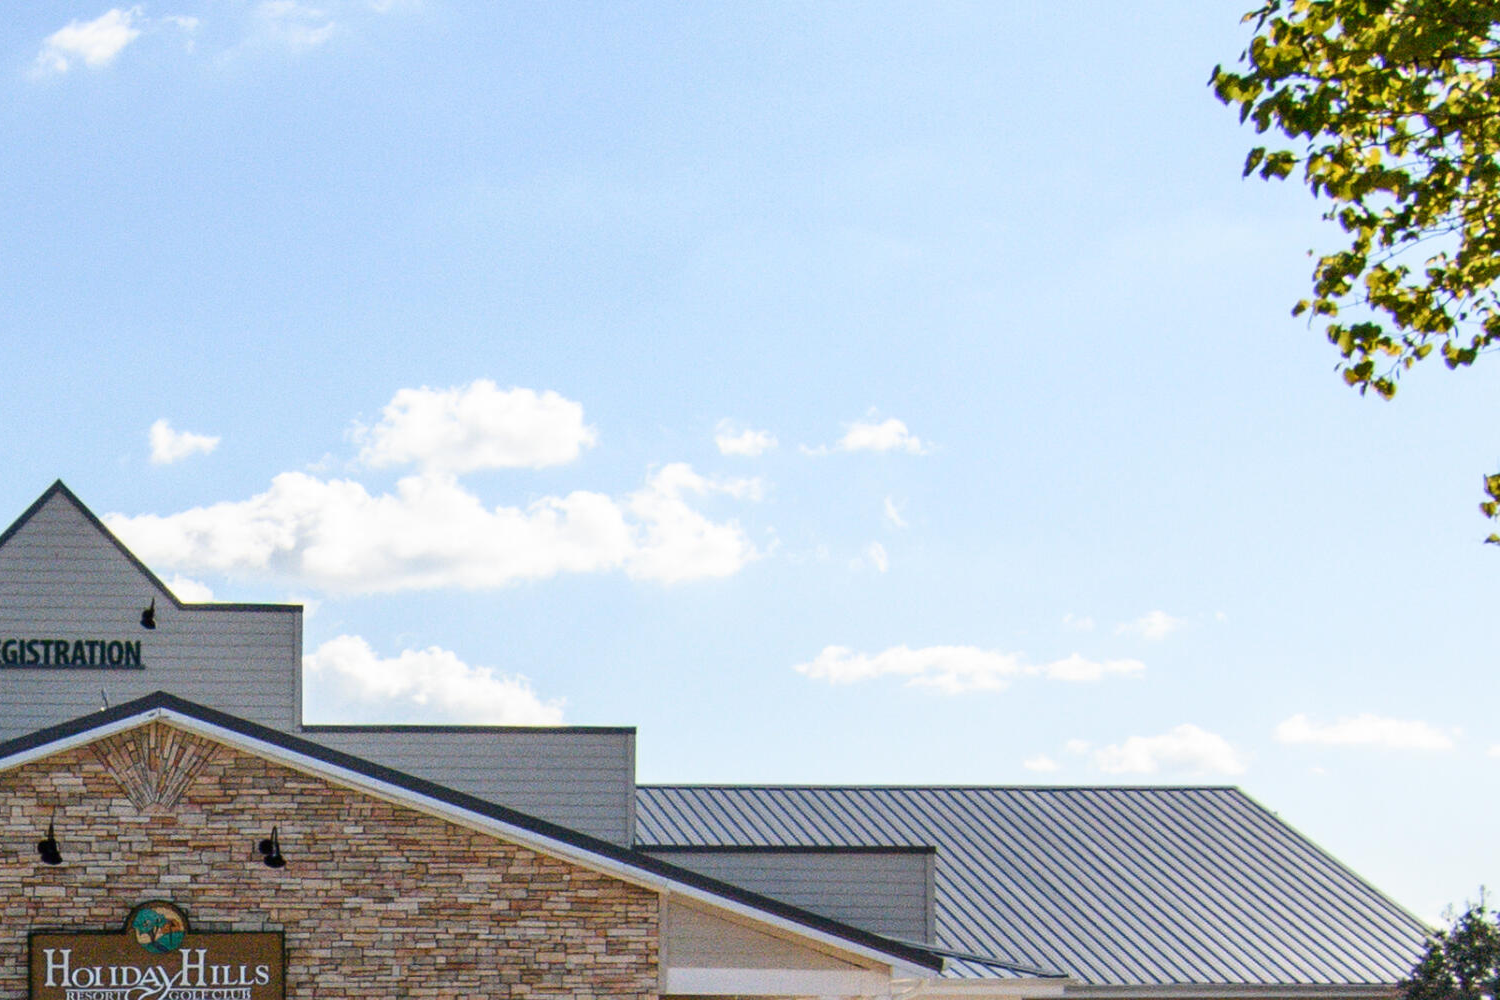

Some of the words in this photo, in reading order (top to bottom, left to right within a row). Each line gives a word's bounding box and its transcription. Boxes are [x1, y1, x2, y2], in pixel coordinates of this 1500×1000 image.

[43, 948, 182, 998] HOLIDAY
[179, 948, 270, 986] HILLS
[168, 990, 209, 1000] GOLF
[211, 990, 251, 1000] CLUB
